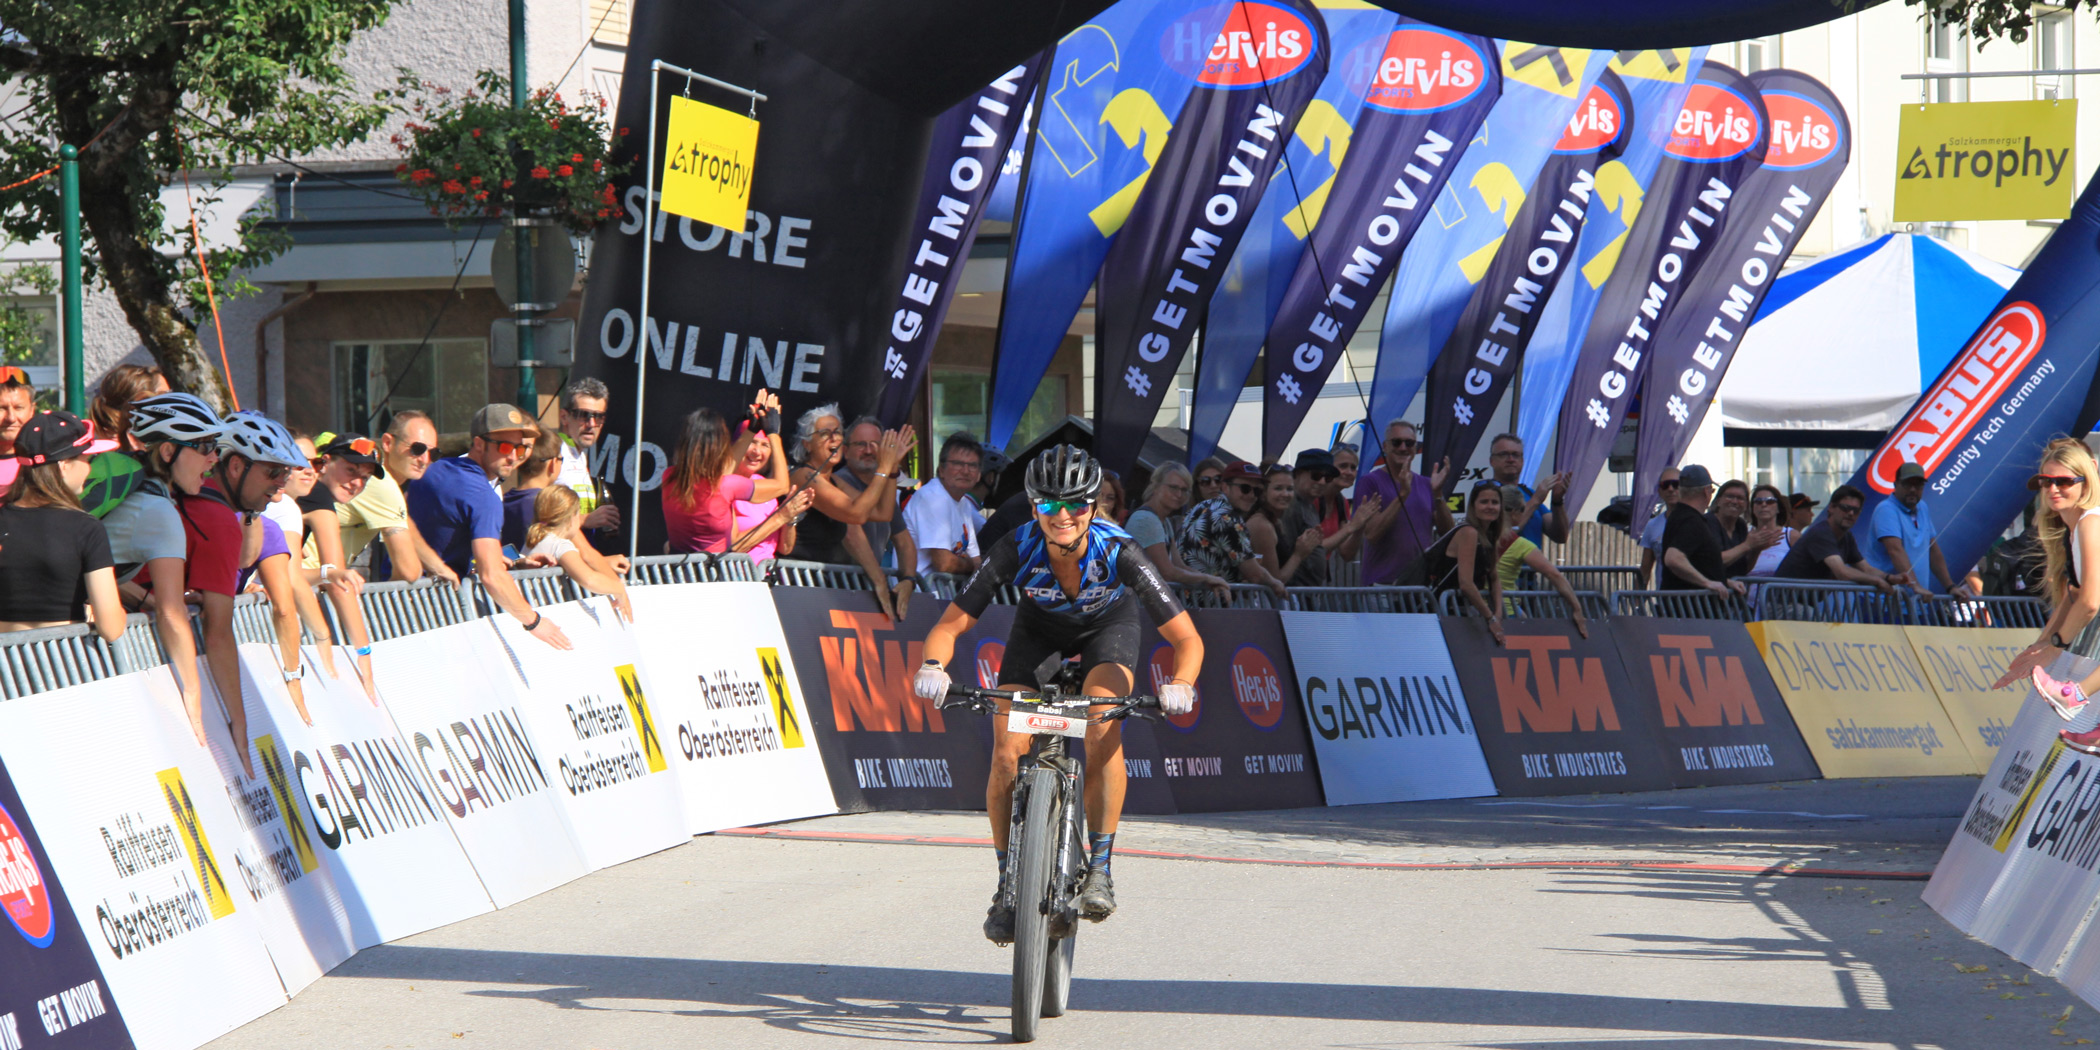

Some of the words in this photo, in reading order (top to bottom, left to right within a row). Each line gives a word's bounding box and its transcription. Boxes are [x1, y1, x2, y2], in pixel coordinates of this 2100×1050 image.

[1173, 22, 1303, 69] Hervis
[1199, 62, 1241, 74] PORTS
[1354, 46, 1475, 95] Hervis
[1771, 115, 1831, 154] rvis
[1935, 136, 2070, 188] trophy
[1948, 136, 2022, 147] Salzkammergut
[691, 142, 751, 200] trophy
[1124, 103, 1285, 398] #GETMOVIN
[1276, 130, 1454, 405] #GETMOVIN
[1453, 168, 1598, 427] #GETMOVIN
[1586, 177, 1733, 429] #GETMOVIN
[1666, 184, 1812, 426] #GETMOVIN
[600, 307, 825, 393] ONLINE
[1894, 325, 2022, 465] ABUS
[1931, 443, 1981, 495] Security
[1974, 414, 2006, 446] Tech
[2001, 358, 2056, 417] Germany
[698, 668, 766, 710] Raiffeisen
[819, 609, 947, 733] KTM
[1233, 664, 1281, 711] Hervis
[1491, 635, 1622, 733] KTM
[1649, 634, 1765, 728] KTM
[1770, 640, 1926, 693] DACHSTEIN
[565, 694, 630, 741] Raiffeisen
[1306, 675, 1465, 741] GARMIN
[413, 706, 549, 819] GARMIN
[678, 712, 778, 762] Oberösterreich
[1244, 755, 1264, 774] GET
[1521, 754, 1553, 778] BIKE
[1554, 751, 1627, 777] INDUSTRIES
[1681, 747, 1709, 771] BIKE
[1710, 744, 1774, 769] INDUSTRIES
[1825, 718, 1944, 756] salzkammergut
[293, 736, 439, 850] GARMIN
[558, 736, 647, 797] Oberösterreich
[854, 758, 887, 789] BIKE
[886, 758, 953, 788] INDUSTRIES
[1164, 757, 1184, 777] GET
[99, 811, 183, 879] Raiffeisen
[95, 869, 209, 961] Oberösterreich
[37, 994, 67, 1037] GET
